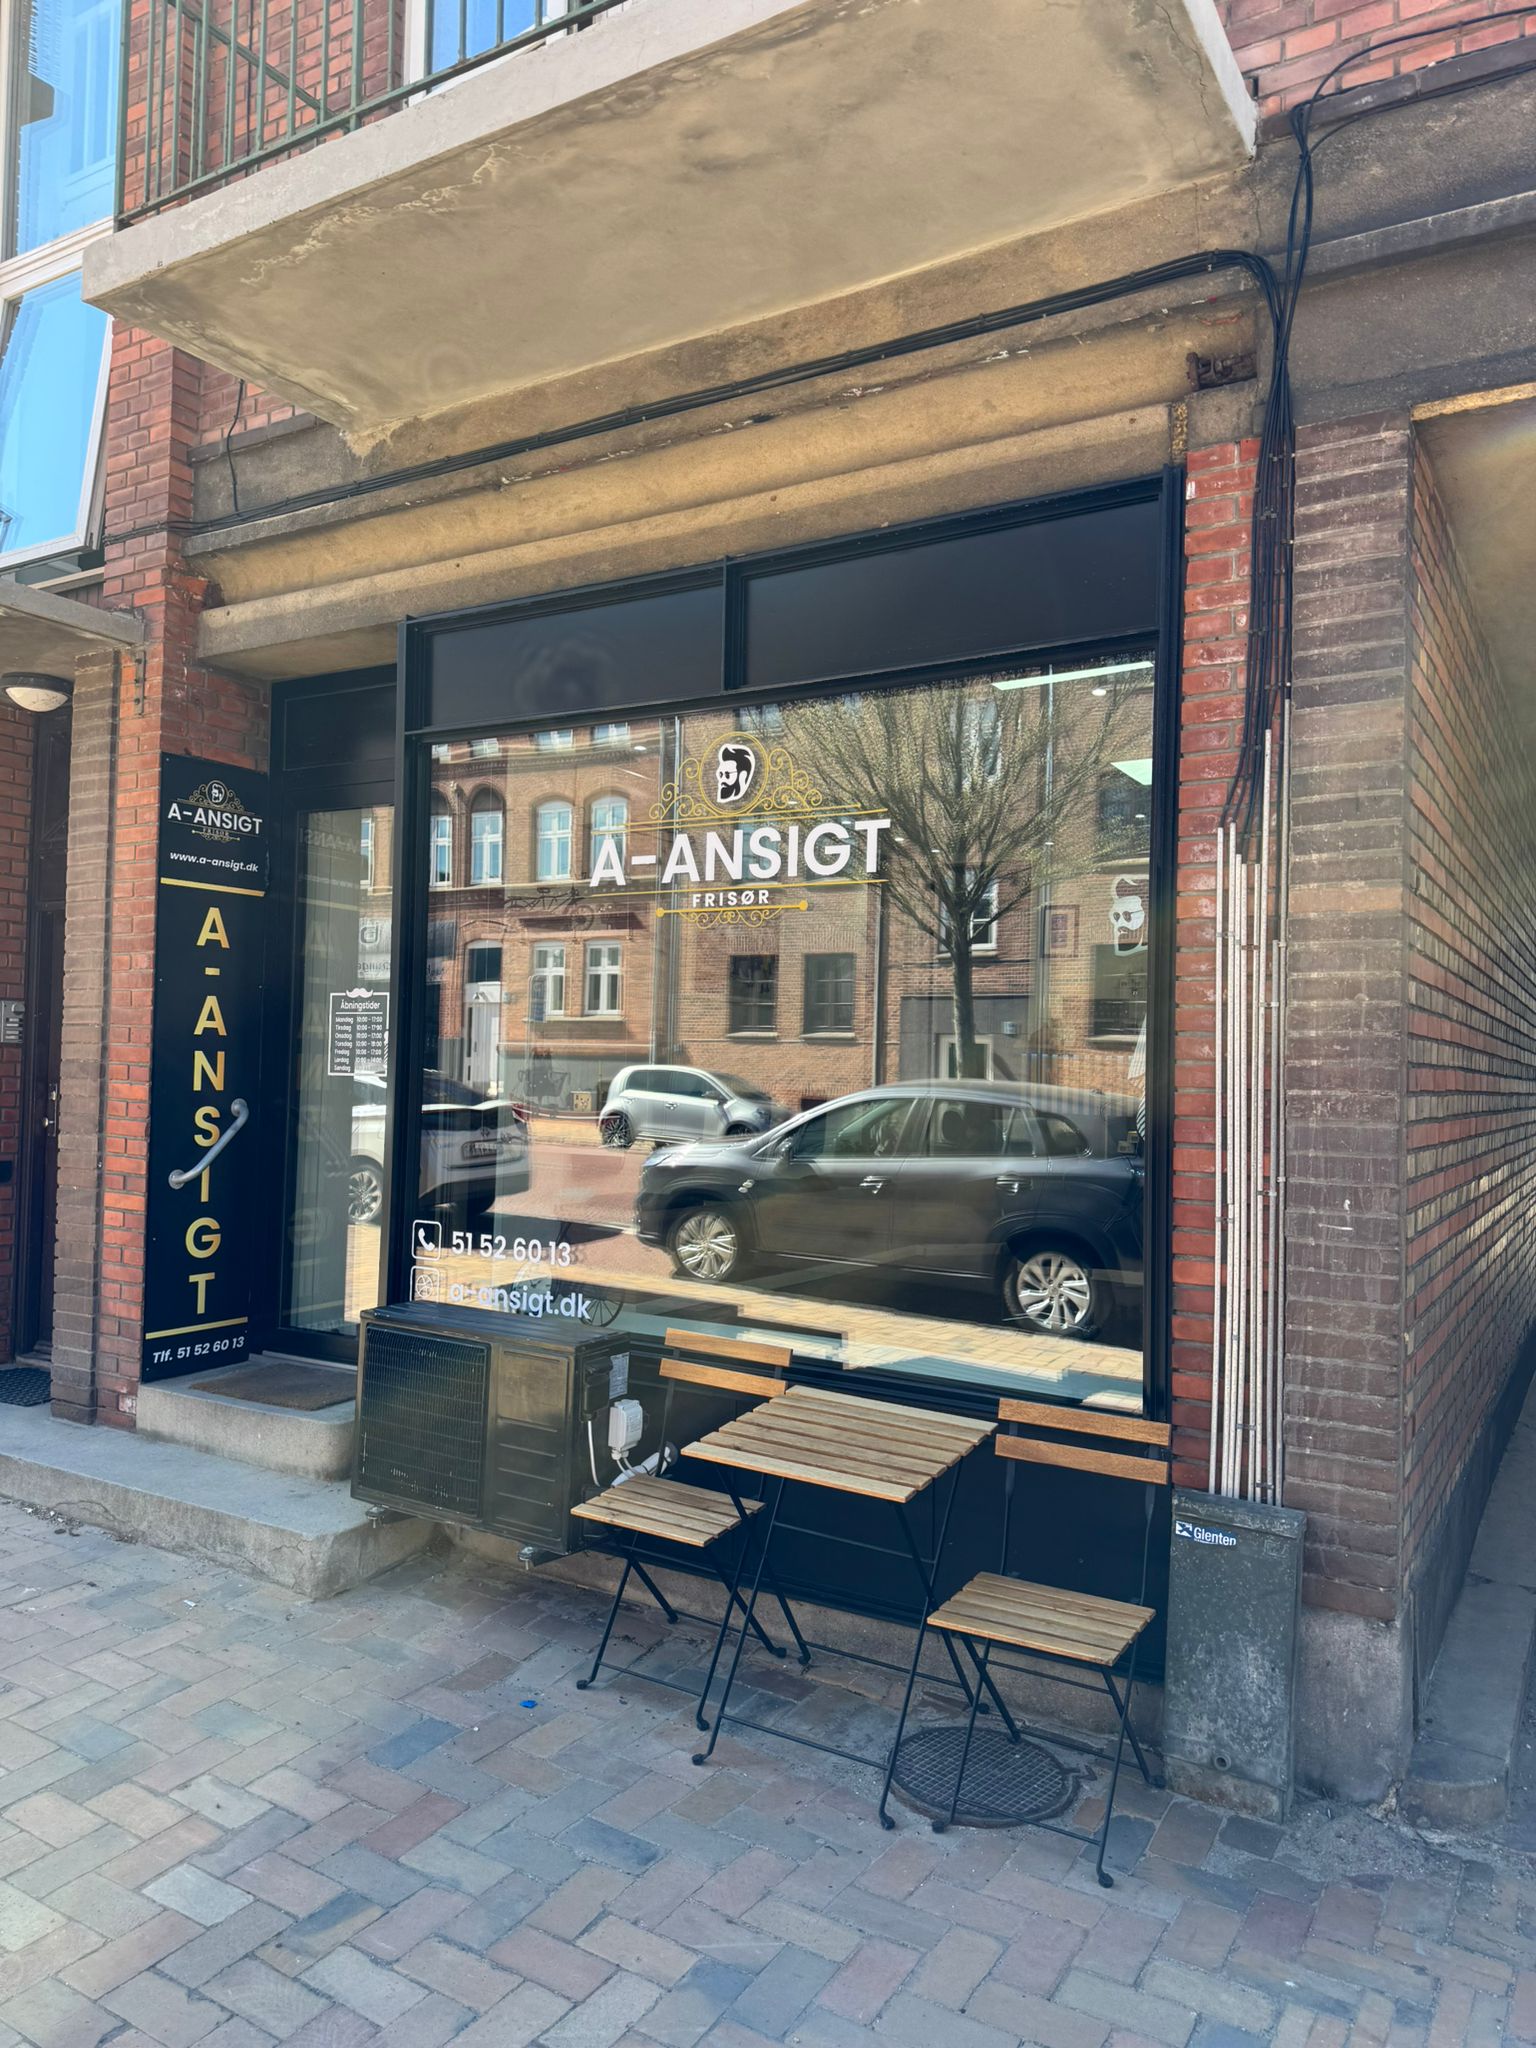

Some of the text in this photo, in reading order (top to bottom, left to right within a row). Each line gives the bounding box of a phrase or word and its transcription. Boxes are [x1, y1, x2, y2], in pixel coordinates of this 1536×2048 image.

[168, 803, 262, 834] A-ANSIGT
[170, 852, 259, 872] www.a-ansigt.dk
[589, 818, 891, 887] A-ANSIGT
[692, 889, 770, 908] FRISØR
[340, 999, 380, 1011] Åbningstider
[452, 1231, 571, 1267] 51 52 60 13
[450, 1283, 591, 1319] a-ansigt.dk
[153, 1336, 245, 1364] Tlf. 51 52 60 13
[1193, 1527, 1237, 1546] Glenten
